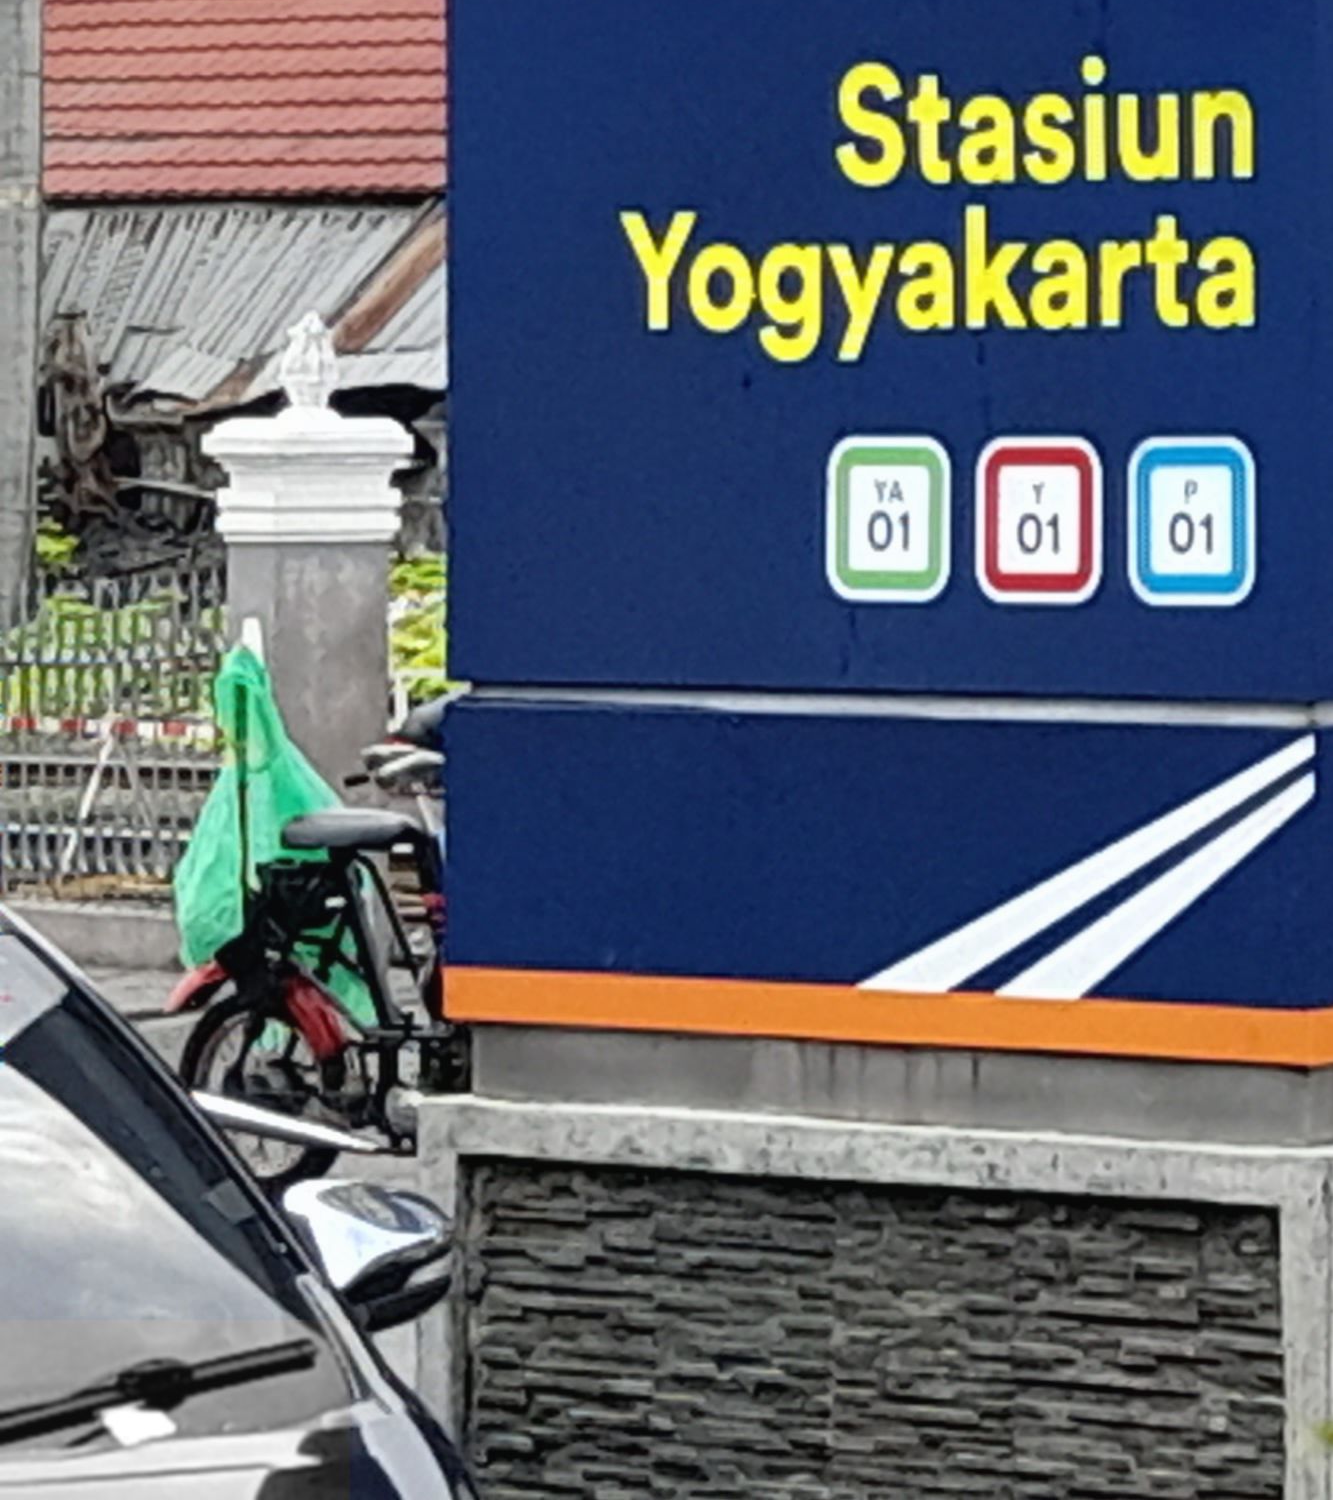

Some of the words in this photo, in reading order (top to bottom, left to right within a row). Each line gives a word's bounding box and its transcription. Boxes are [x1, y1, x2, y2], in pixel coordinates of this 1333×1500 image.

[834, 54, 1254, 188] Stasiun
[618, 204, 1257, 363] Yogyakarta
[873, 479, 905, 504] YA
[1031, 481, 1046, 505] Y
[1183, 479, 1198, 504] P
[867, 510, 911, 552] 01
[1016, 512, 1061, 555] 01
[1168, 511, 1215, 556] 01
